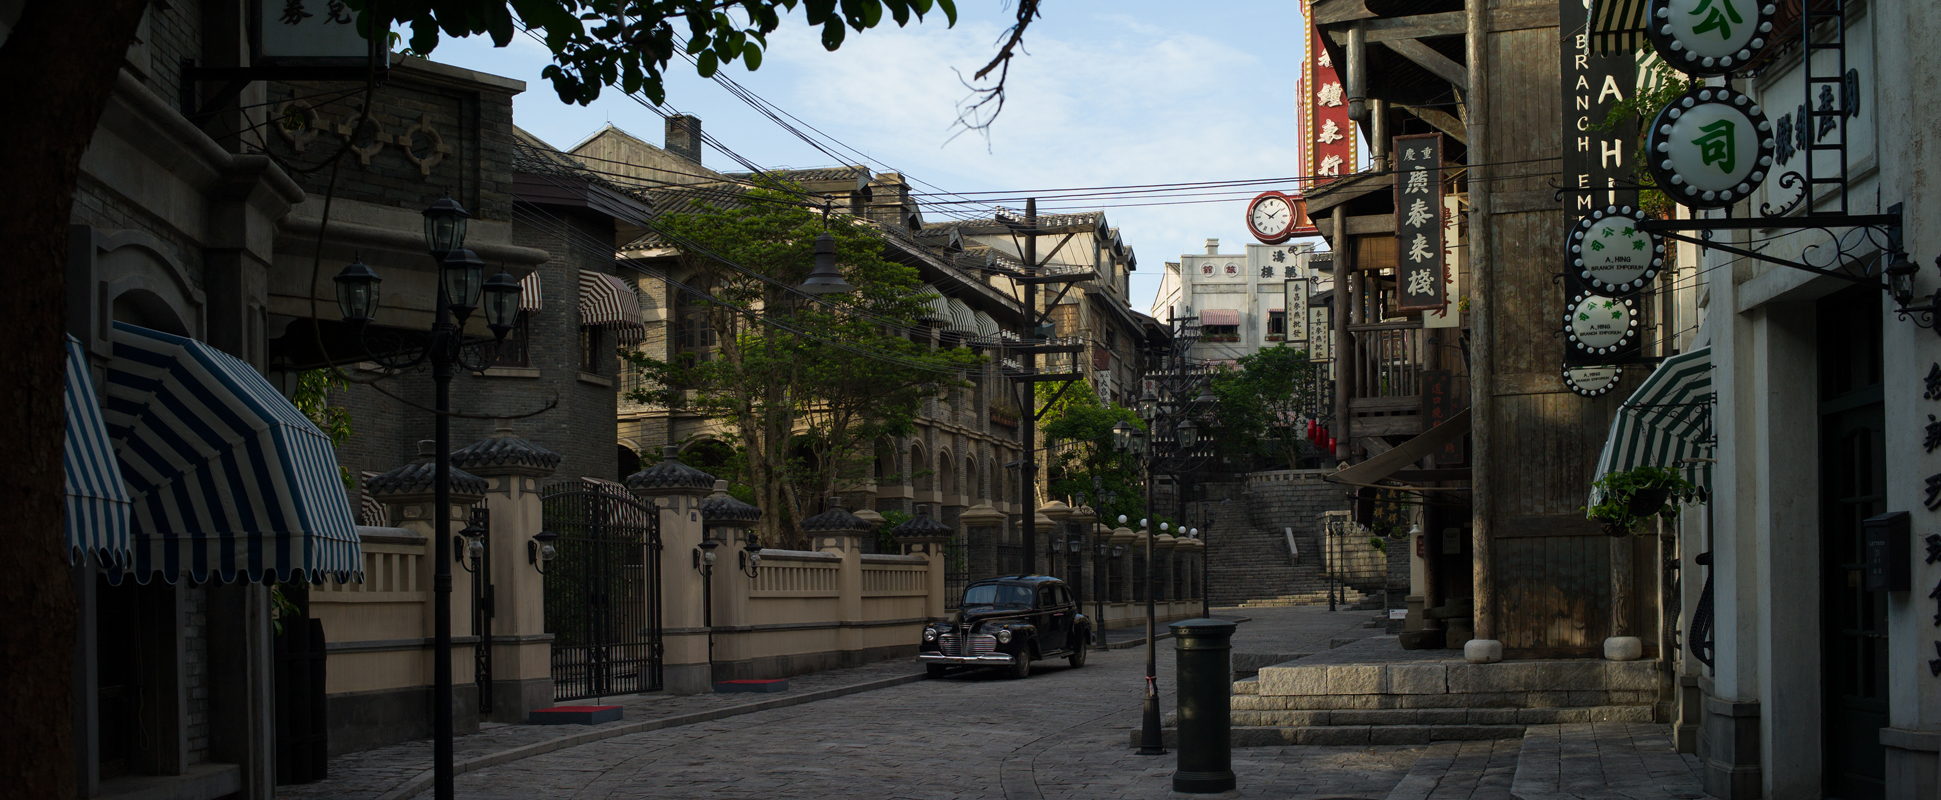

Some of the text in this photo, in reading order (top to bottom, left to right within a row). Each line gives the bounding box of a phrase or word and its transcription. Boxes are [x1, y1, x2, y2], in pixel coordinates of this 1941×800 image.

[1403, 146, 1433, 162] 重慶
[1575, 34, 1592, 221] BRANCH EM
